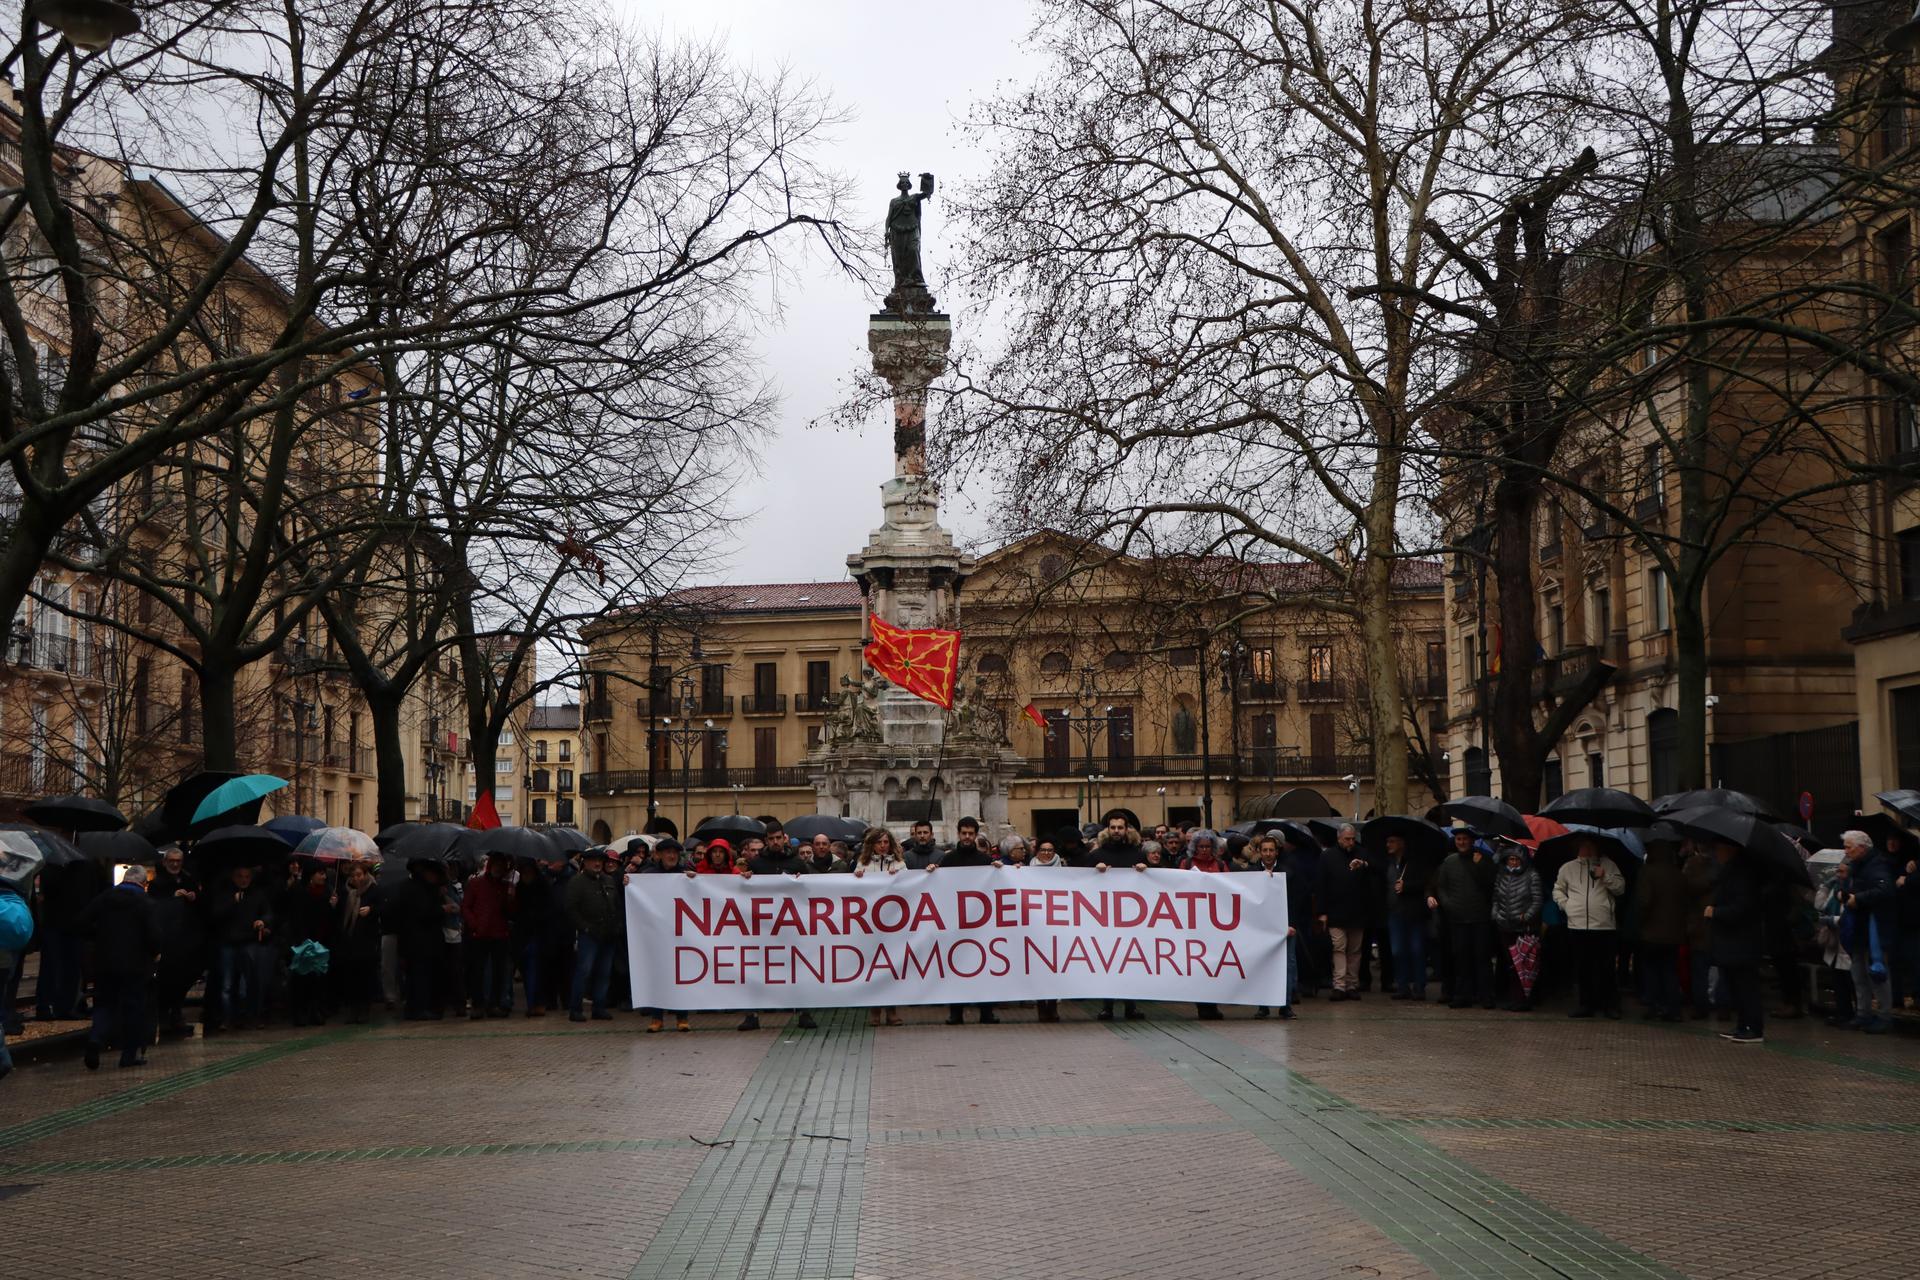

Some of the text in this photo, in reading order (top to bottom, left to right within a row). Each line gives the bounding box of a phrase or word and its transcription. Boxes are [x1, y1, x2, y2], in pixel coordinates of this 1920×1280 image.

[674, 888, 1242, 937] NAFARROA DEFENDATU
[674, 936, 1246, 985] DEFENDAMOS NAVARRA
